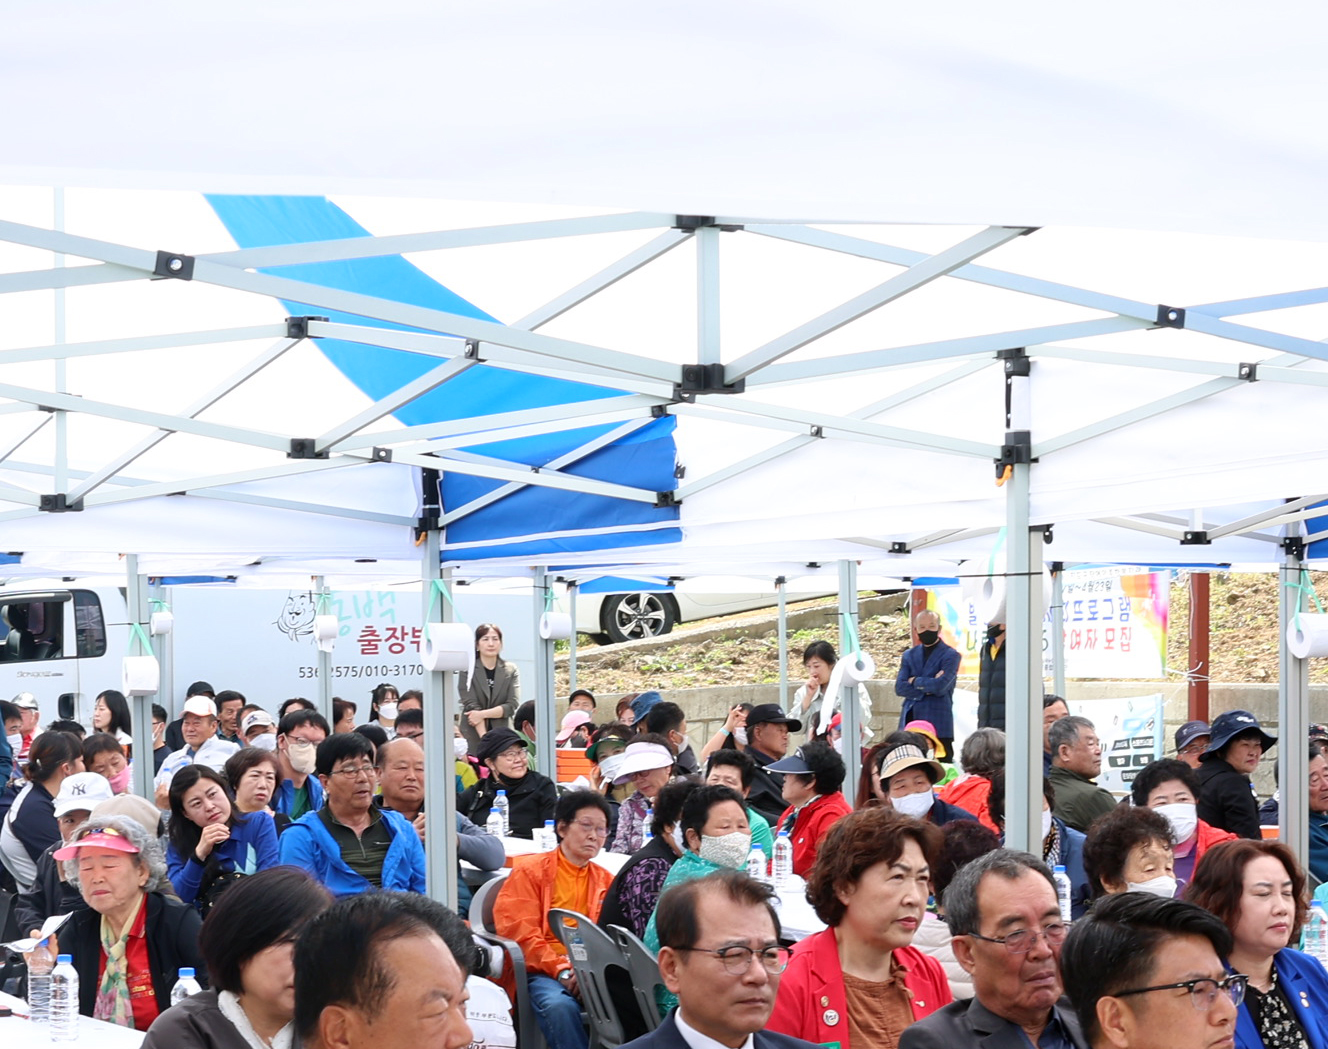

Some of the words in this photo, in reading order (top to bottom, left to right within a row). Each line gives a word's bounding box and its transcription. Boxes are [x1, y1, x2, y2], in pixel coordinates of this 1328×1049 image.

[1063, 629, 1099, 651] 여자
[1104, 626, 1133, 653] 모집
[71, 782, 86, 796] NY
